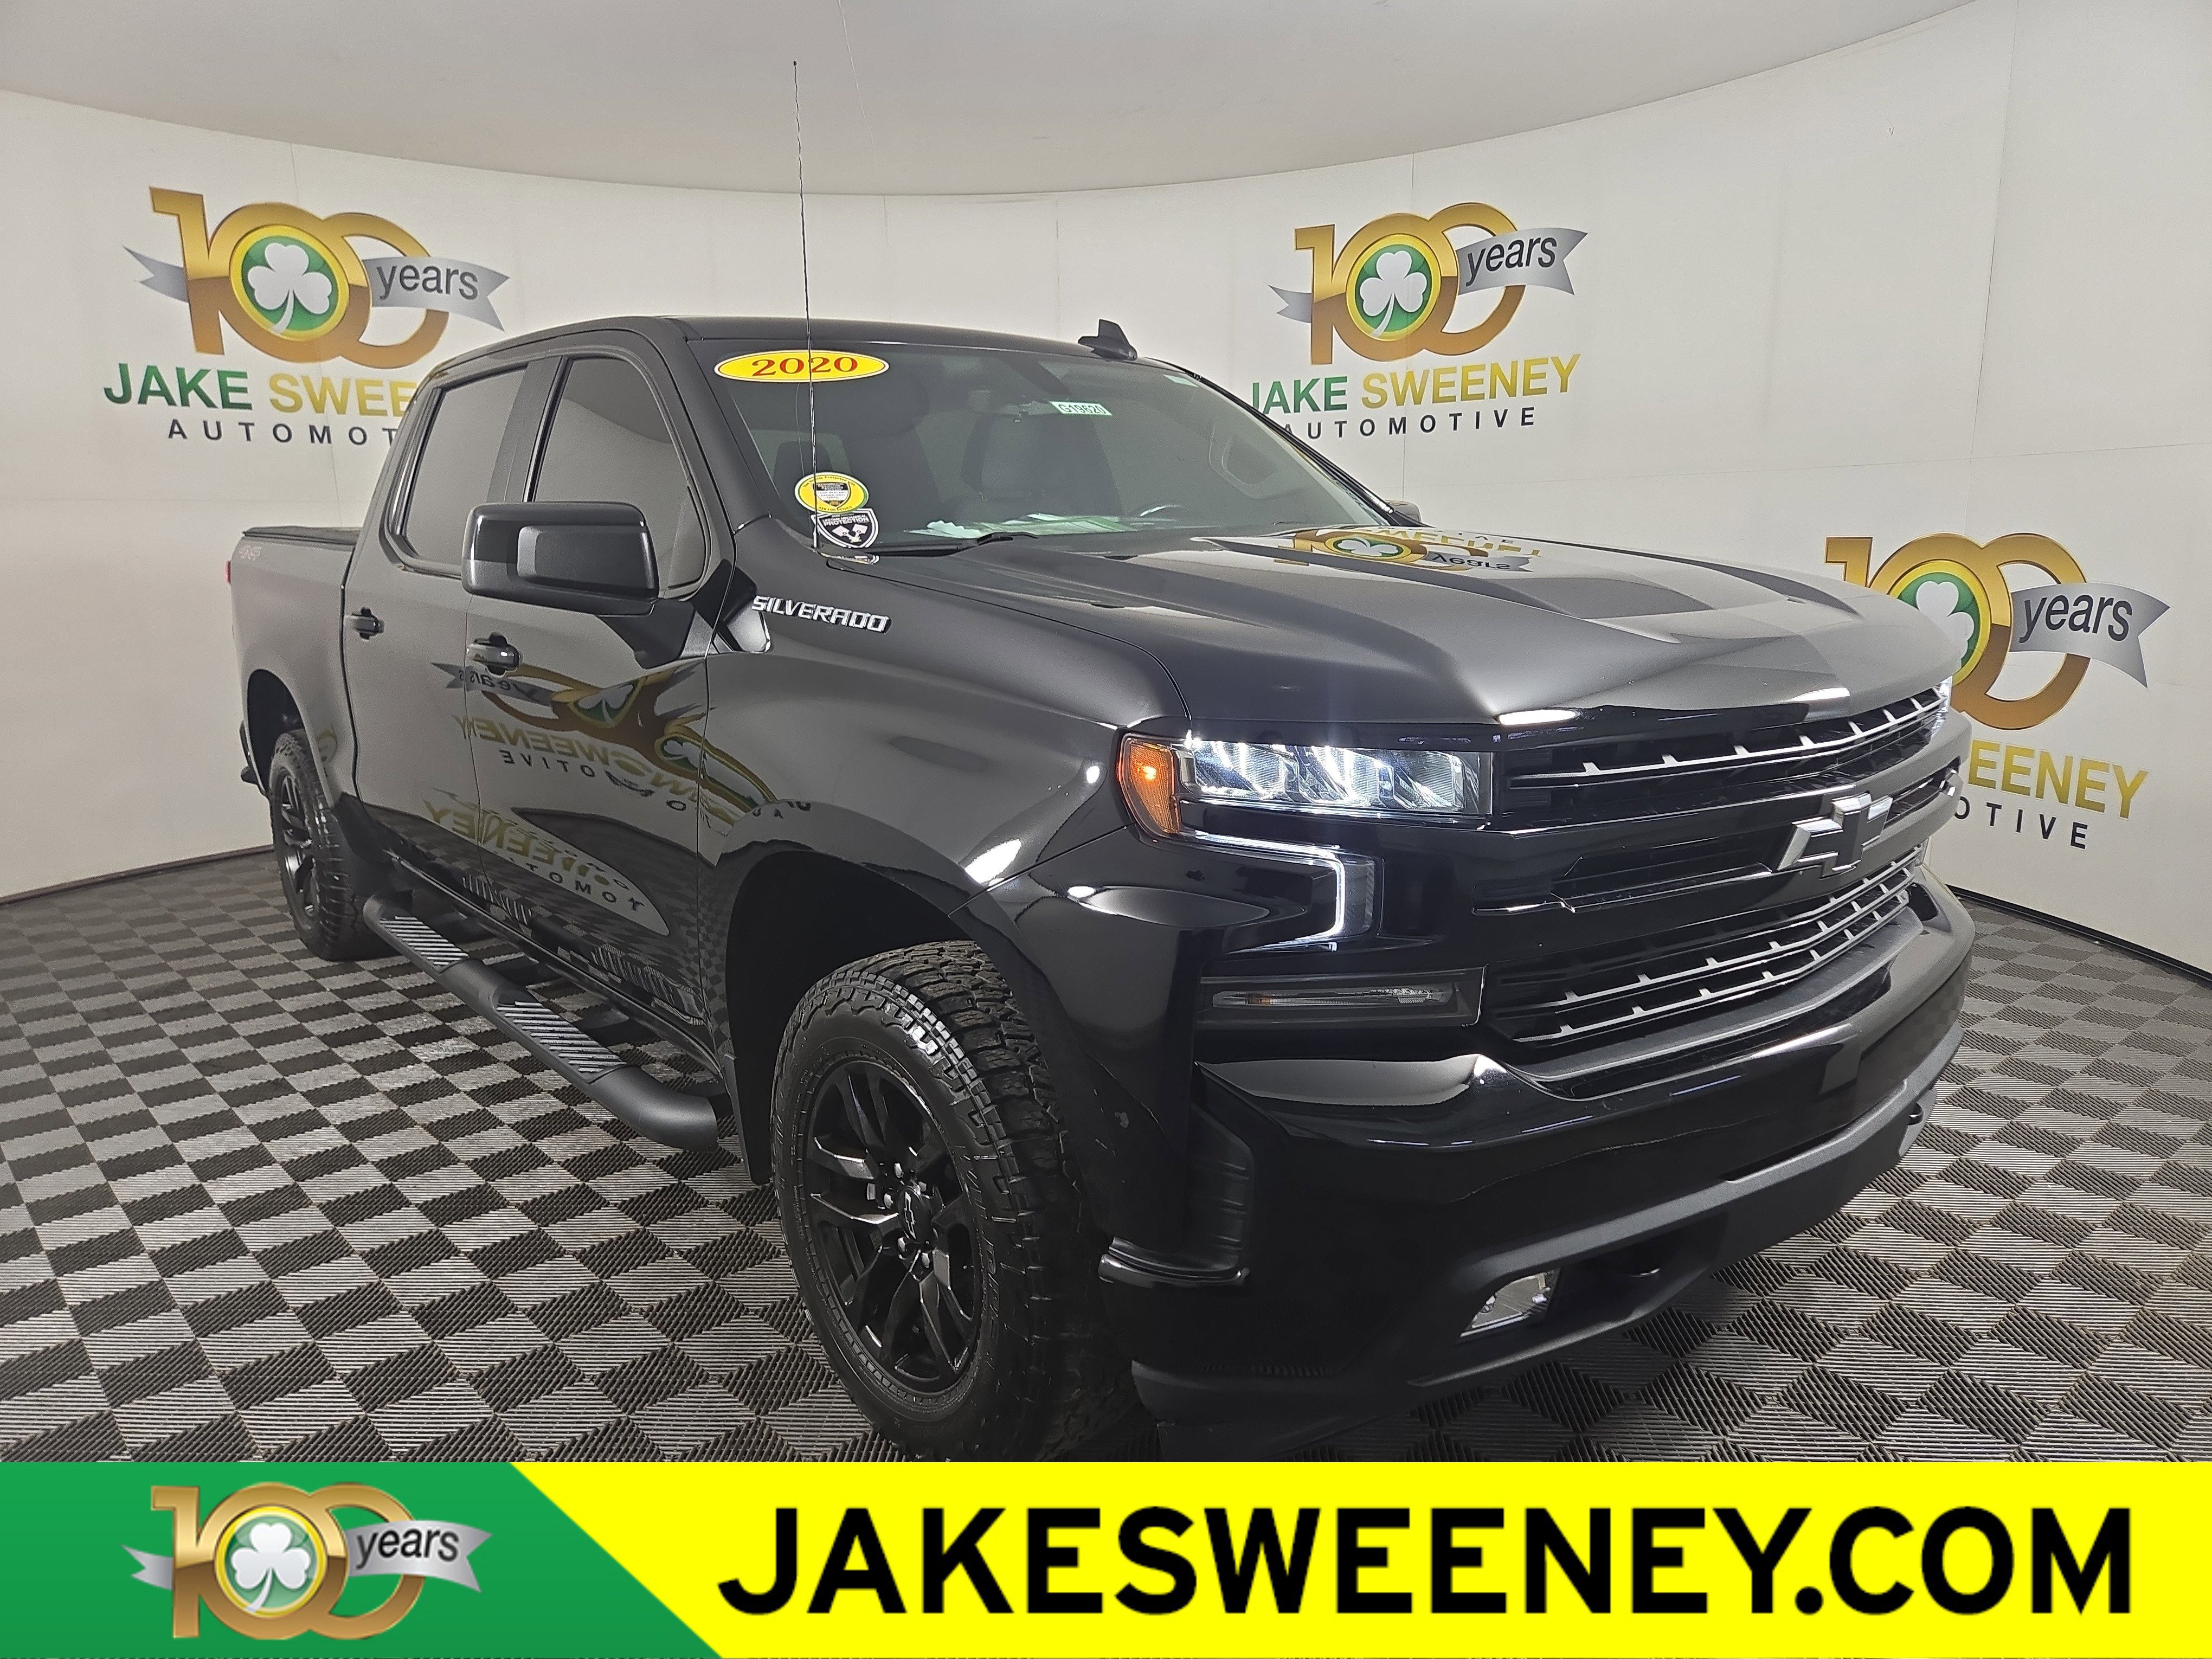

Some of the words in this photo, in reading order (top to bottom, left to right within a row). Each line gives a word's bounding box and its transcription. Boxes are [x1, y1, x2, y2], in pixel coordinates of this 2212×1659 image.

[376, 262, 479, 301] years
[1465, 236, 1557, 287] years
[103, 362, 253, 410] JAKE
[269, 373, 417, 417] SWEE
[751, 356, 859, 377] 2020
[1361, 353, 1581, 409] SWEENEY
[168, 418, 397, 446] AUTOMOT
[751, 595, 891, 634] SILVERADO
[2018, 594, 2132, 643] years
[1968, 739, 2150, 819] EENEY
[1954, 796, 2088, 850] OTIVE
